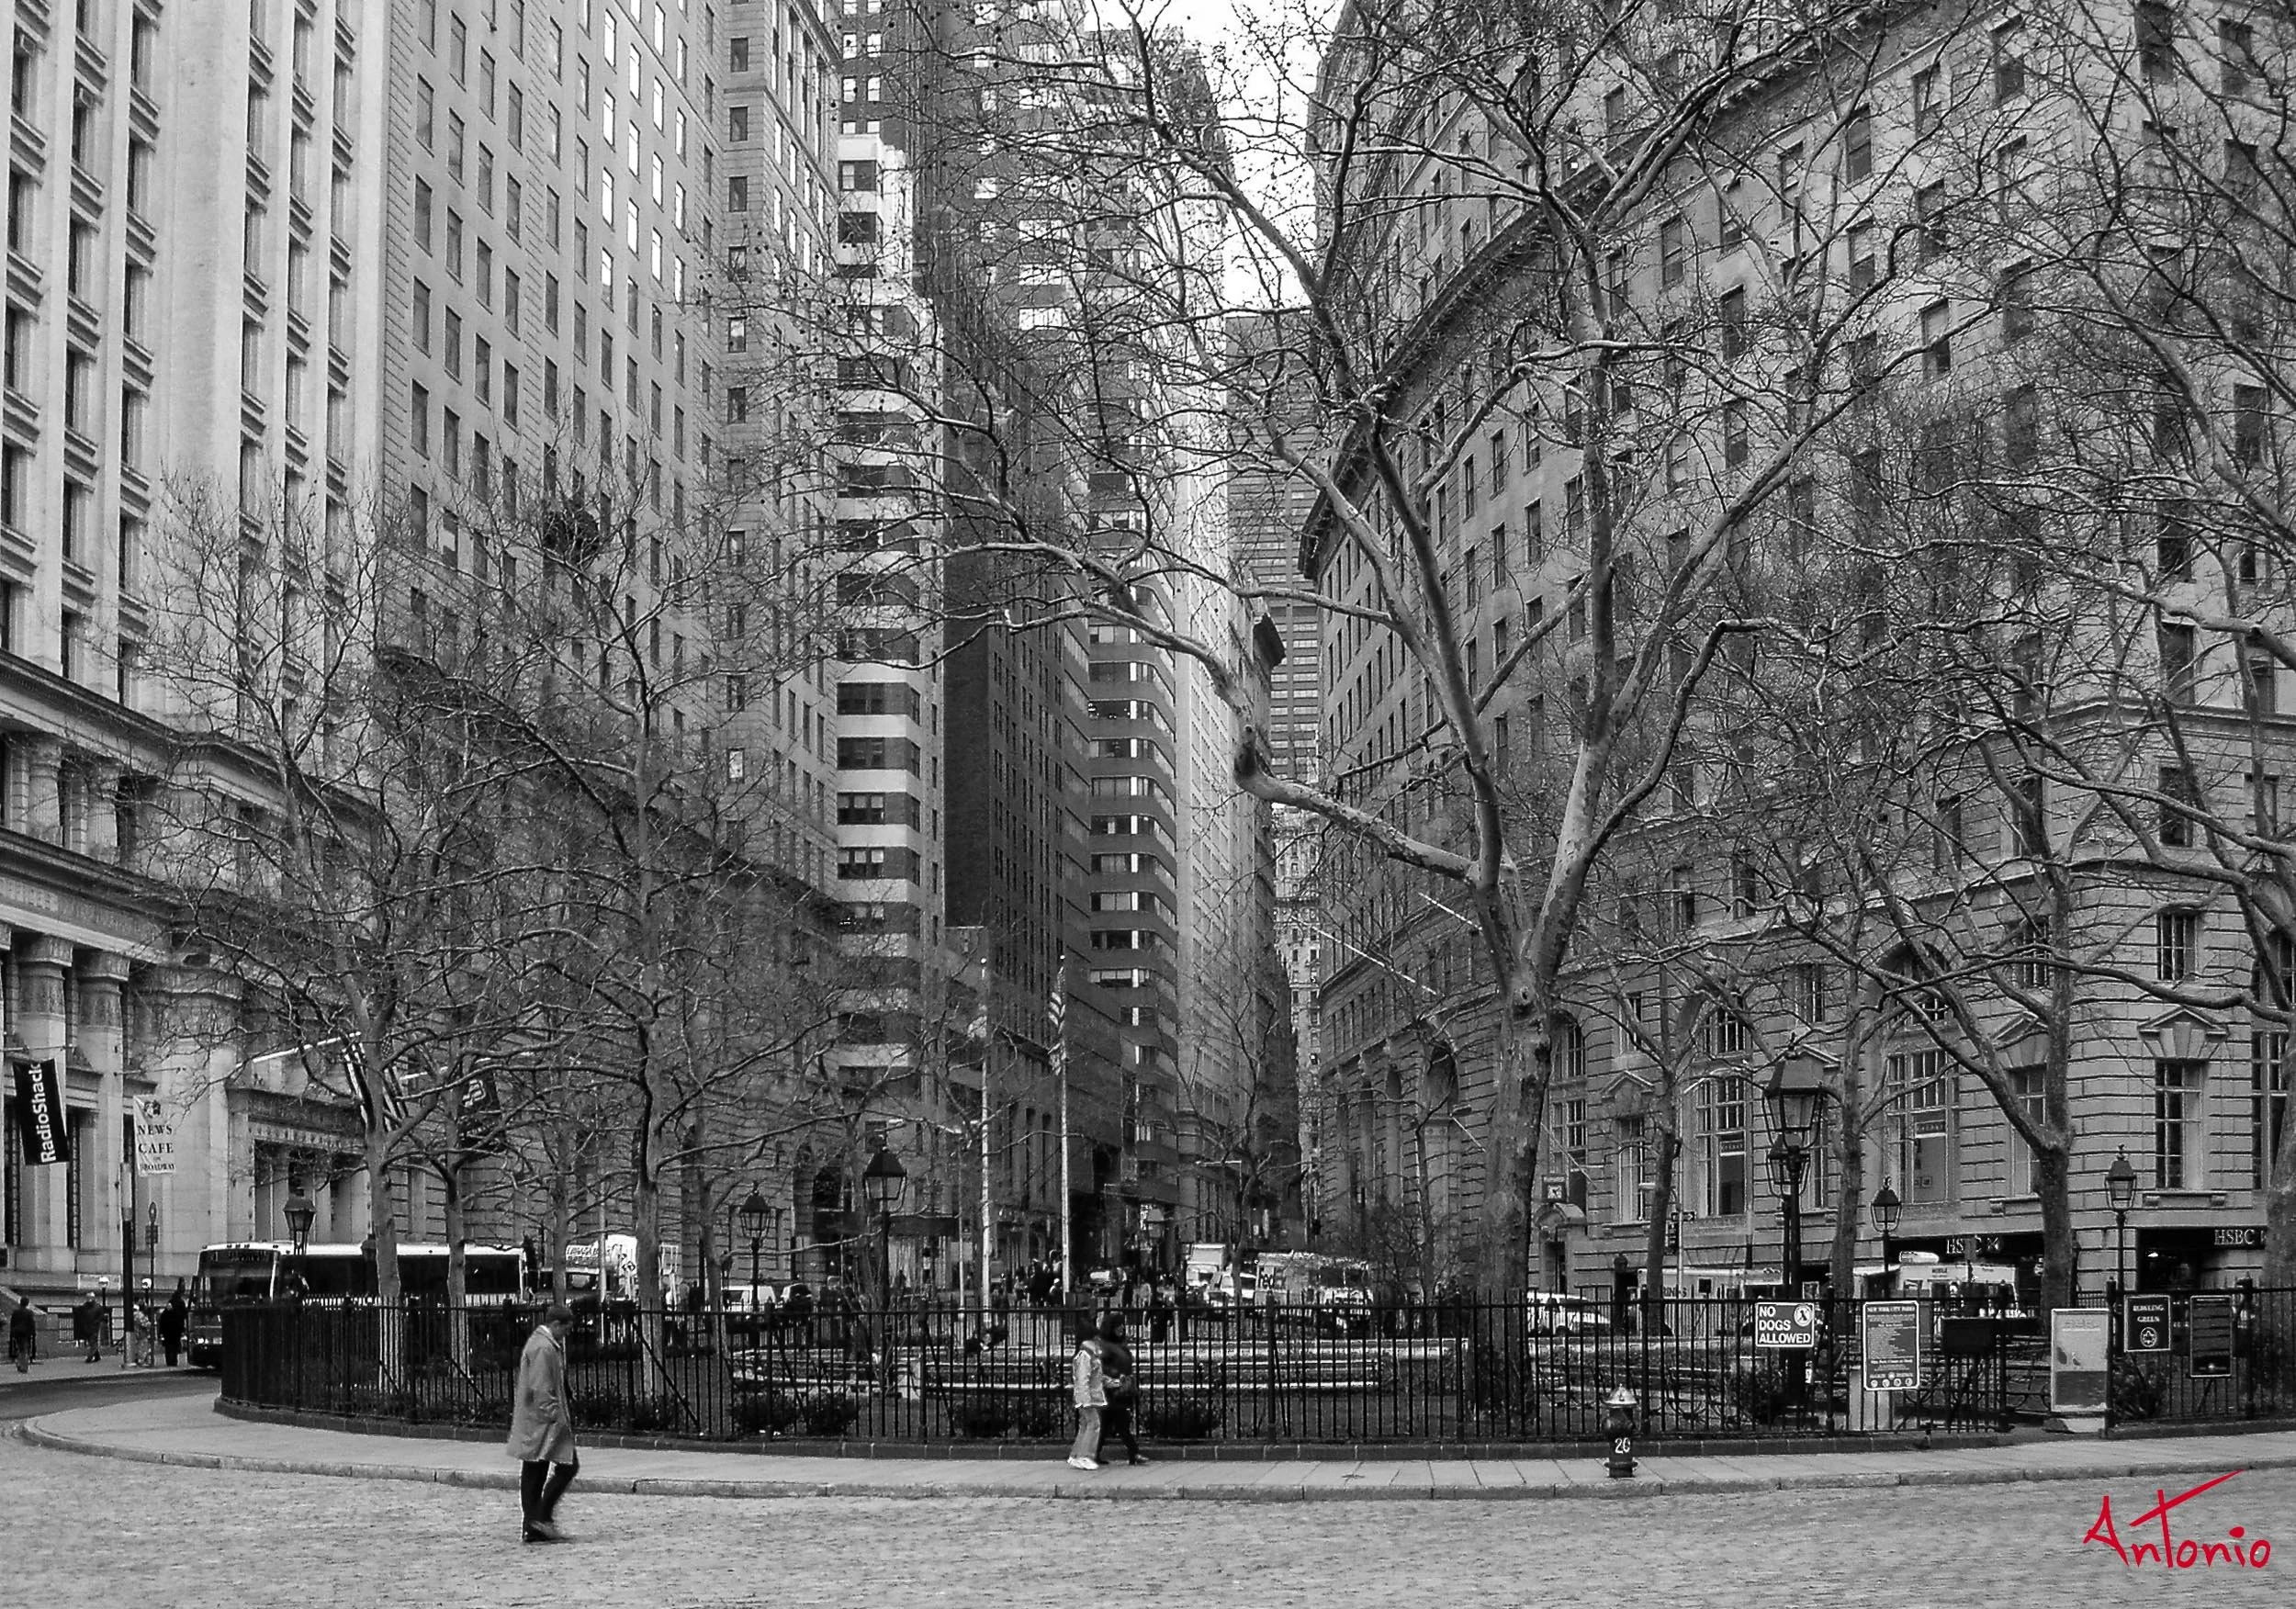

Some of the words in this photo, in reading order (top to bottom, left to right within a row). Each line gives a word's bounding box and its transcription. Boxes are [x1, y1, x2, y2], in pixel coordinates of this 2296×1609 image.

[28, 1063, 56, 1163] RadioShack
[139, 1124, 173, 1135] NEWS
[139, 1142, 174, 1153] CAFE
[2214, 1229, 2255, 1245] HSBC
[1946, 1234, 1982, 1255] HSC
[1759, 1306, 1776, 1317] NO
[1759, 1320, 1791, 1331] DOGS
[1759, 1333, 1811, 1344] ALLOWED
